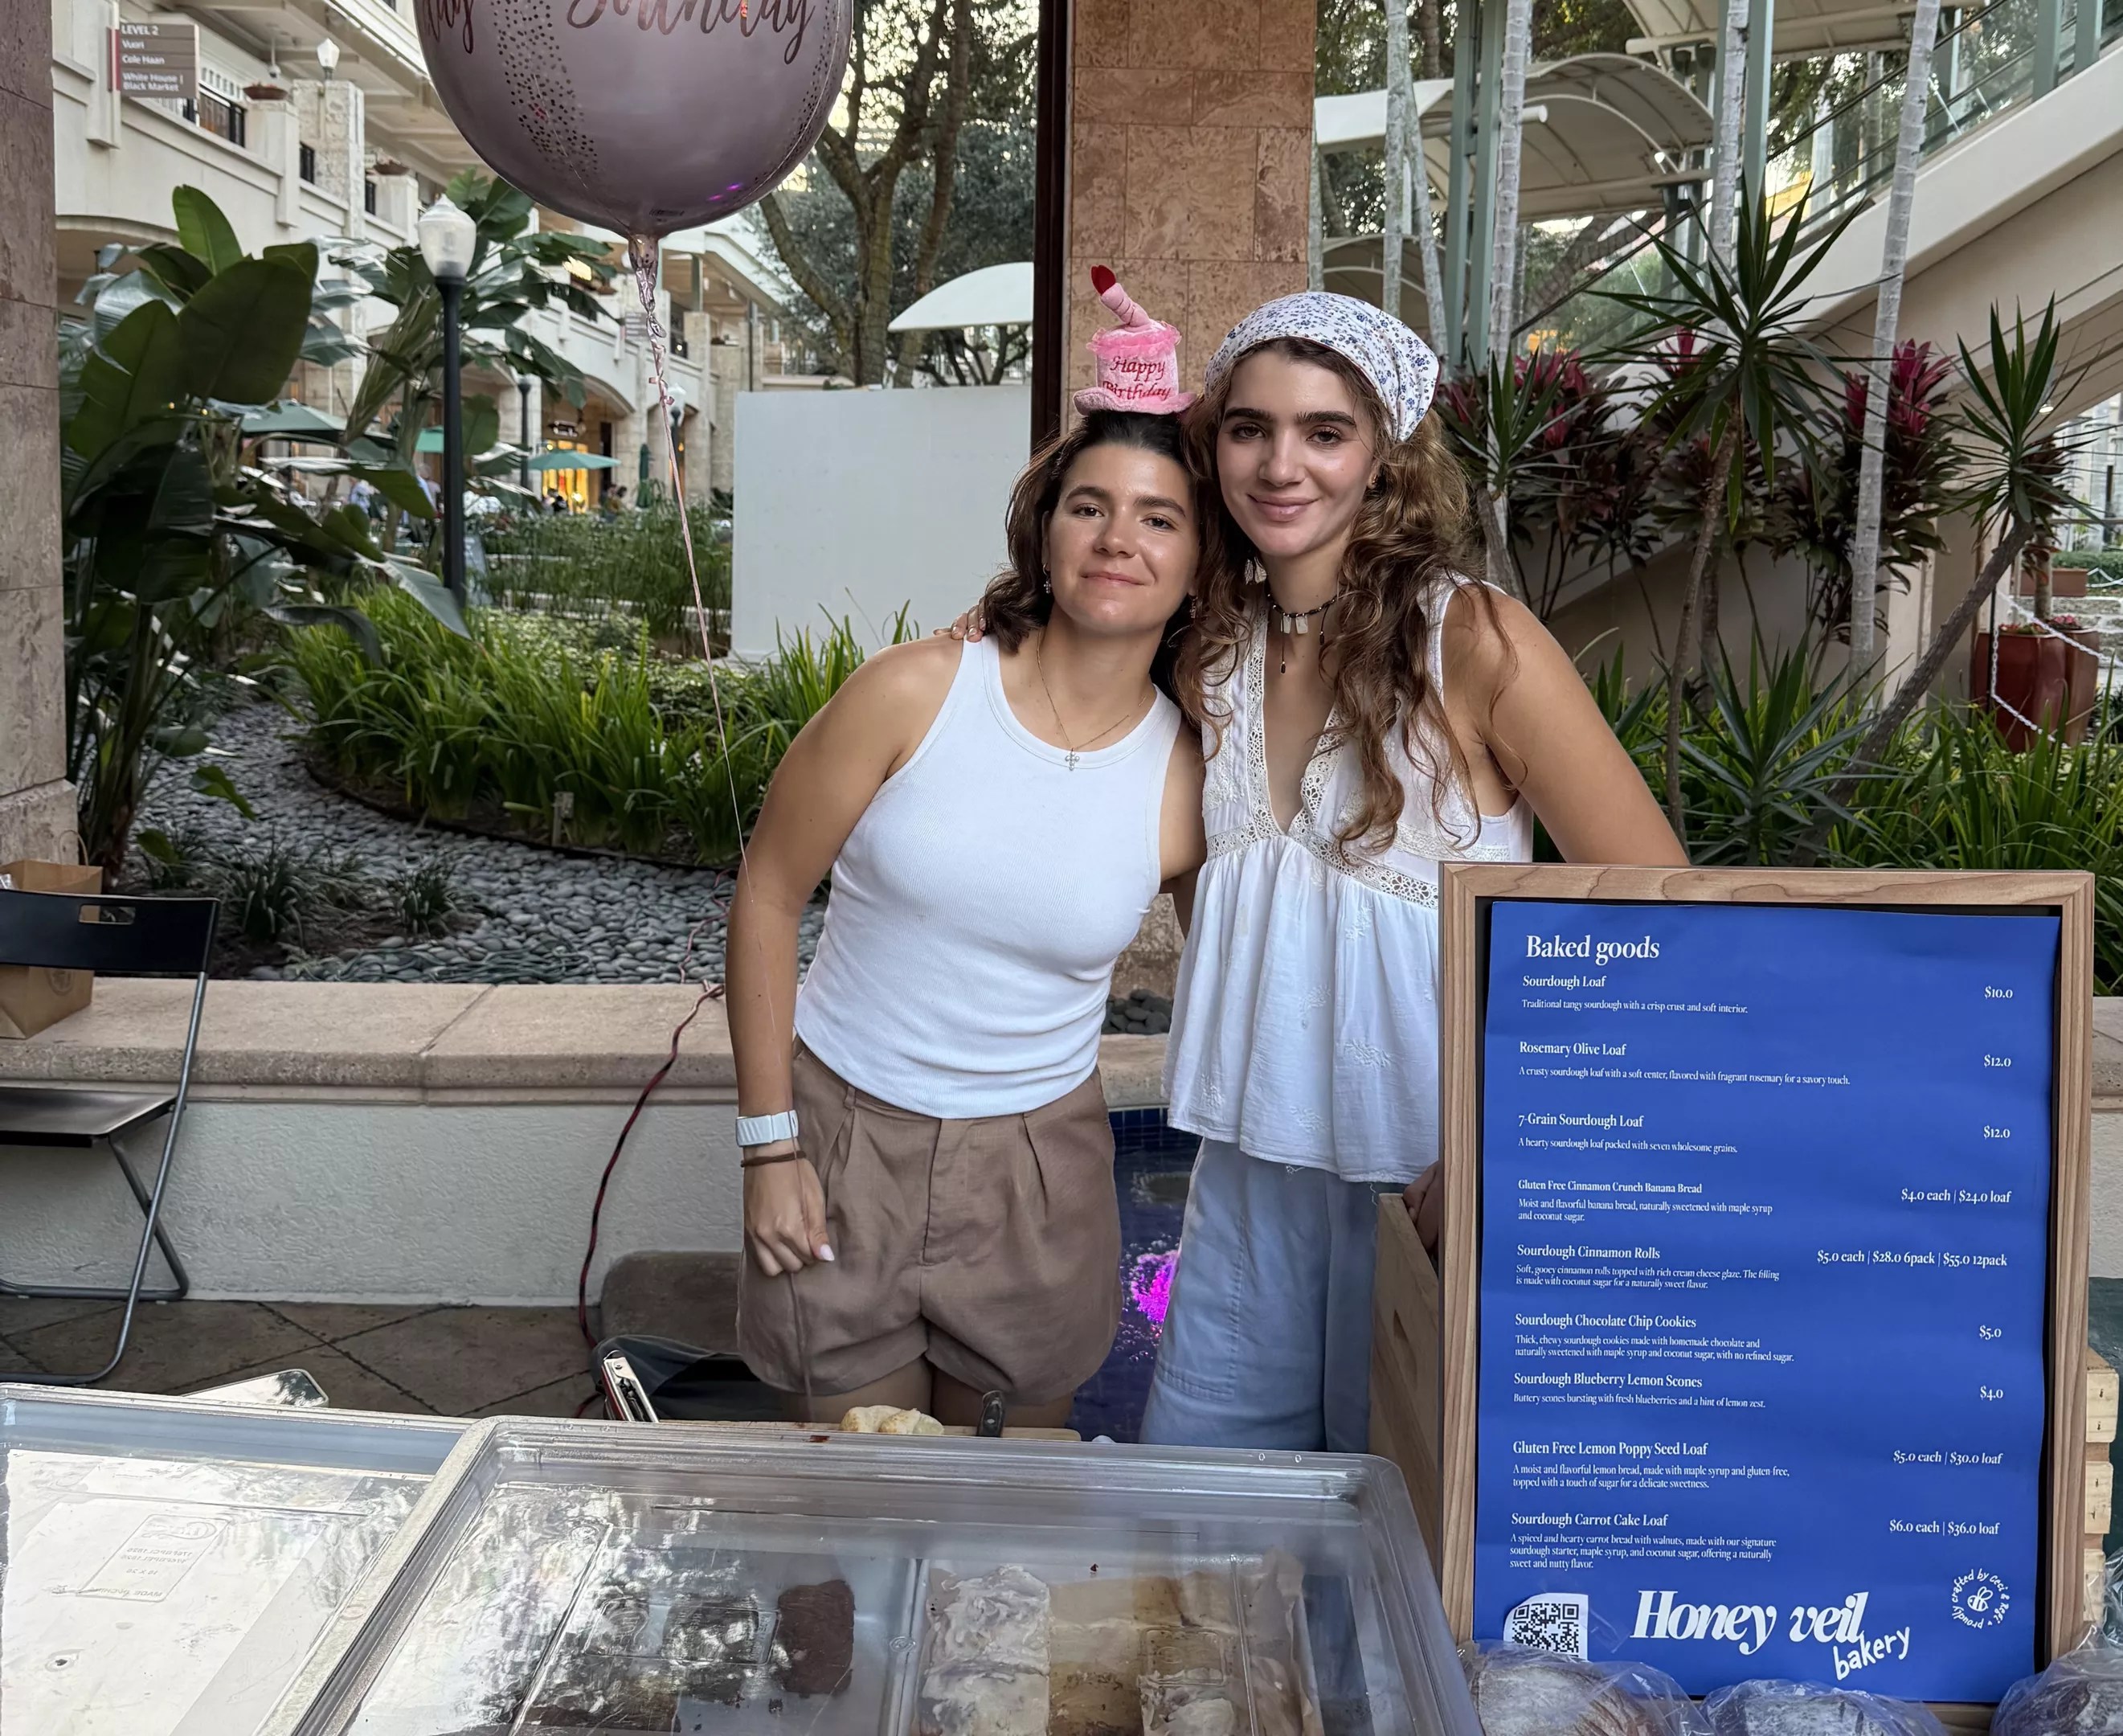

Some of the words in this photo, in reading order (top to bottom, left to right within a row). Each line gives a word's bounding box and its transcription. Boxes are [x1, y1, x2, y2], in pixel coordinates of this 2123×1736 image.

[121, 25, 150, 35] LEVEL
[152, 25, 159, 35] 2
[122, 55, 141, 64] Cole
[142, 56, 165, 64] Haan
[123, 72, 149, 81] White
[149, 74, 178, 82] House
[123, 82, 146, 90] Black
[148, 83, 178, 92] Market
[1110, 355, 1166, 382] Happy
[1102, 381, 1171, 401] Birthday
[1525, 934, 1591, 958] Baked
[1594, 935, 1660, 966] goods
[1522, 974, 1581, 991] Sourdough
[1582, 975, 1607, 987] Loaf
[1984, 985, 2014, 999] $10.0
[1521, 998, 1562, 1009] Traditional
[1563, 1001, 1582, 1011] tangy
[1583, 1000, 1622, 1012] sourdough
[1622, 1001, 1640, 1009] with
[1646, 1001, 1666, 1013] crisp
[1666, 1003, 1685, 1011] crust
[1686, 1002, 1701, 1011] and
[1701, 1002, 1717, 1012] soft
[1718, 1003, 1749, 1013] interior.
[1520, 1041, 1572, 1058] Rosemary
[1573, 1042, 1601, 1055] Olive
[1602, 1043, 1627, 1056] Loaf
[1983, 1054, 2012, 1067] $12.0
[1519, 1066, 1525, 1075] A
[1525, 1068, 1549, 1079] crusty
[1549, 1067, 1589, 1079] sourdough
[1589, 1067, 1605, 1077] loaf
[1604, 1068, 1622, 1078] with
[1628, 1068, 1642, 1078] soft
[1643, 1071, 1668, 1080] center,
[1669, 1070, 1699, 1080] flavored
[1699, 1071, 1716, 1080] with
[1717, 1071, 1748, 1084] fragrant
[1749, 1075, 1783, 1086] rosemary
[1784, 1073, 1796, 1083] for
[1802, 1076, 1826, 1087] savory
[1827, 1075, 1851, 1084] touch.
[1518, 1112, 1557, 1127] 7-Grain
[1558, 1113, 1617, 1130] Sourdough
[1619, 1115, 1645, 1128] Loaf
[1983, 1125, 2011, 1139] $12.0
[1518, 1137, 1524, 1146] A
[1525, 1137, 1549, 1150] hearty
[1549, 1138, 1589, 1151] sourdough
[1589, 1139, 1605, 1148] loaf
[1604, 1140, 1631, 1151] packed
[1631, 1140, 1649, 1150] with
[1649, 1143, 1671, 1151] seven
[1671, 1141, 1712, 1152] wholesome
[1712, 1144, 1738, 1155] grains.
[1518, 1179, 1546, 1189] Gluten
[1548, 1180, 1566, 1190] Free
[1567, 1180, 1611, 1191] Cinnamon
[1612, 1181, 1643, 1192] Crunch
[1645, 1182, 1676, 1193] Banana
[1677, 1183, 1702, 1194] Bread
[1900, 1188, 1925, 1202] $4.0
[1926, 1189, 1951, 1201] each
[1958, 1189, 1988, 1205] $24.0
[1990, 1189, 2012, 1203] loaf
[1516, 1244, 1576, 1260] Sourdough
[1577, 1246, 1632, 1259] Cinnamon
[1634, 1247, 1661, 1259] Rolls
[1817, 1249, 1839, 1264] $5.0
[1840, 1250, 1865, 1262] each
[1871, 1250, 1902, 1264] $28.0
[1903, 1251, 1936, 1267] 6pack
[1942, 1251, 1970, 1267] $55.0
[1973, 1253, 2007, 1269] 12pack
[1515, 1312, 1573, 1330] Sourdough
[1574, 1313, 1627, 1327] Chocolate
[1628, 1314, 1654, 1331] Chip
[1654, 1315, 1697, 1328] Cookies
[1515, 1334, 1539, 1345] Thick,
[1538, 1334, 1563, 1349] chewy
[1563, 1335, 1601, 1349] sourdough
[1601, 1335, 1630, 1345] cookies
[1630, 1336, 1651, 1345] made
[1651, 1336, 1668, 1345] with
[1668, 1336, 1709, 1346] homemade
[1710, 1337, 1745, 1348] chocolate
[1745, 1338, 1761, 1349] and
[1978, 1325, 2002, 1341] $5.0
[1513, 1372, 1572, 1389] Sourdough
[1573, 1373, 1626, 1389] Blueberry
[1627, 1374, 1664, 1386] Lemon
[1665, 1374, 1703, 1388] Scones
[1979, 1385, 2004, 1401] $4.0
[1512, 1440, 1550, 1454] Gluten
[1552, 1441, 1577, 1455] Free
[1578, 1441, 1617, 1455] Lemon
[1618, 1442, 1653, 1459] Poppy
[1654, 1441, 1680, 1456] Seed
[1682, 1442, 1709, 1456] Loaf
[1892, 1450, 1916, 1464] $5.0
[1917, 1451, 1942, 1462] each
[1949, 1451, 1980, 1466] $30.0
[1981, 1452, 2004, 1464] loaf
[1512, 1476, 1540, 1489] topped
[1540, 1476, 1558, 1487] with
[1559, 1479, 1565, 1487] a
[1565, 1476, 1588, 1487] touch
[1588, 1476, 1598, 1487] of
[1597, 1480, 1620, 1490] sugar
[1620, 1476, 1632, 1488] for
[1632, 1480, 1638, 1488] a
[1638, 1477, 1669, 1488] delicate
[1669, 1477, 1710, 1488] sweetness.
[1511, 1512, 1573, 1529] Sourdough
[1574, 1513, 1612, 1525] Carrot
[1613, 1513, 1641, 1526] Cake
[1642, 1513, 1669, 1526] Loaf
[1889, 1519, 1914, 1533] $6.0
[1915, 1520, 1940, 1533] each
[1947, 1521, 1977, 1537] $36.0
[1978, 1521, 2001, 1535] loaf
[1509, 1559, 1532, 1568] sweet
[1532, 1558, 1548, 1568] and
[1548, 1560, 1570, 1571] nutty
[1570, 1558, 1594, 1569] flavor.
[1977, 1568, 1990, 1582] by
[1952, 1569, 1975, 1603] crafted
[1630, 1591, 1777, 1656] Honey
[1790, 1591, 1870, 1644] veil
[1952, 1606, 1985, 1629] proudly
[1833, 1626, 1911, 1681] bakery
